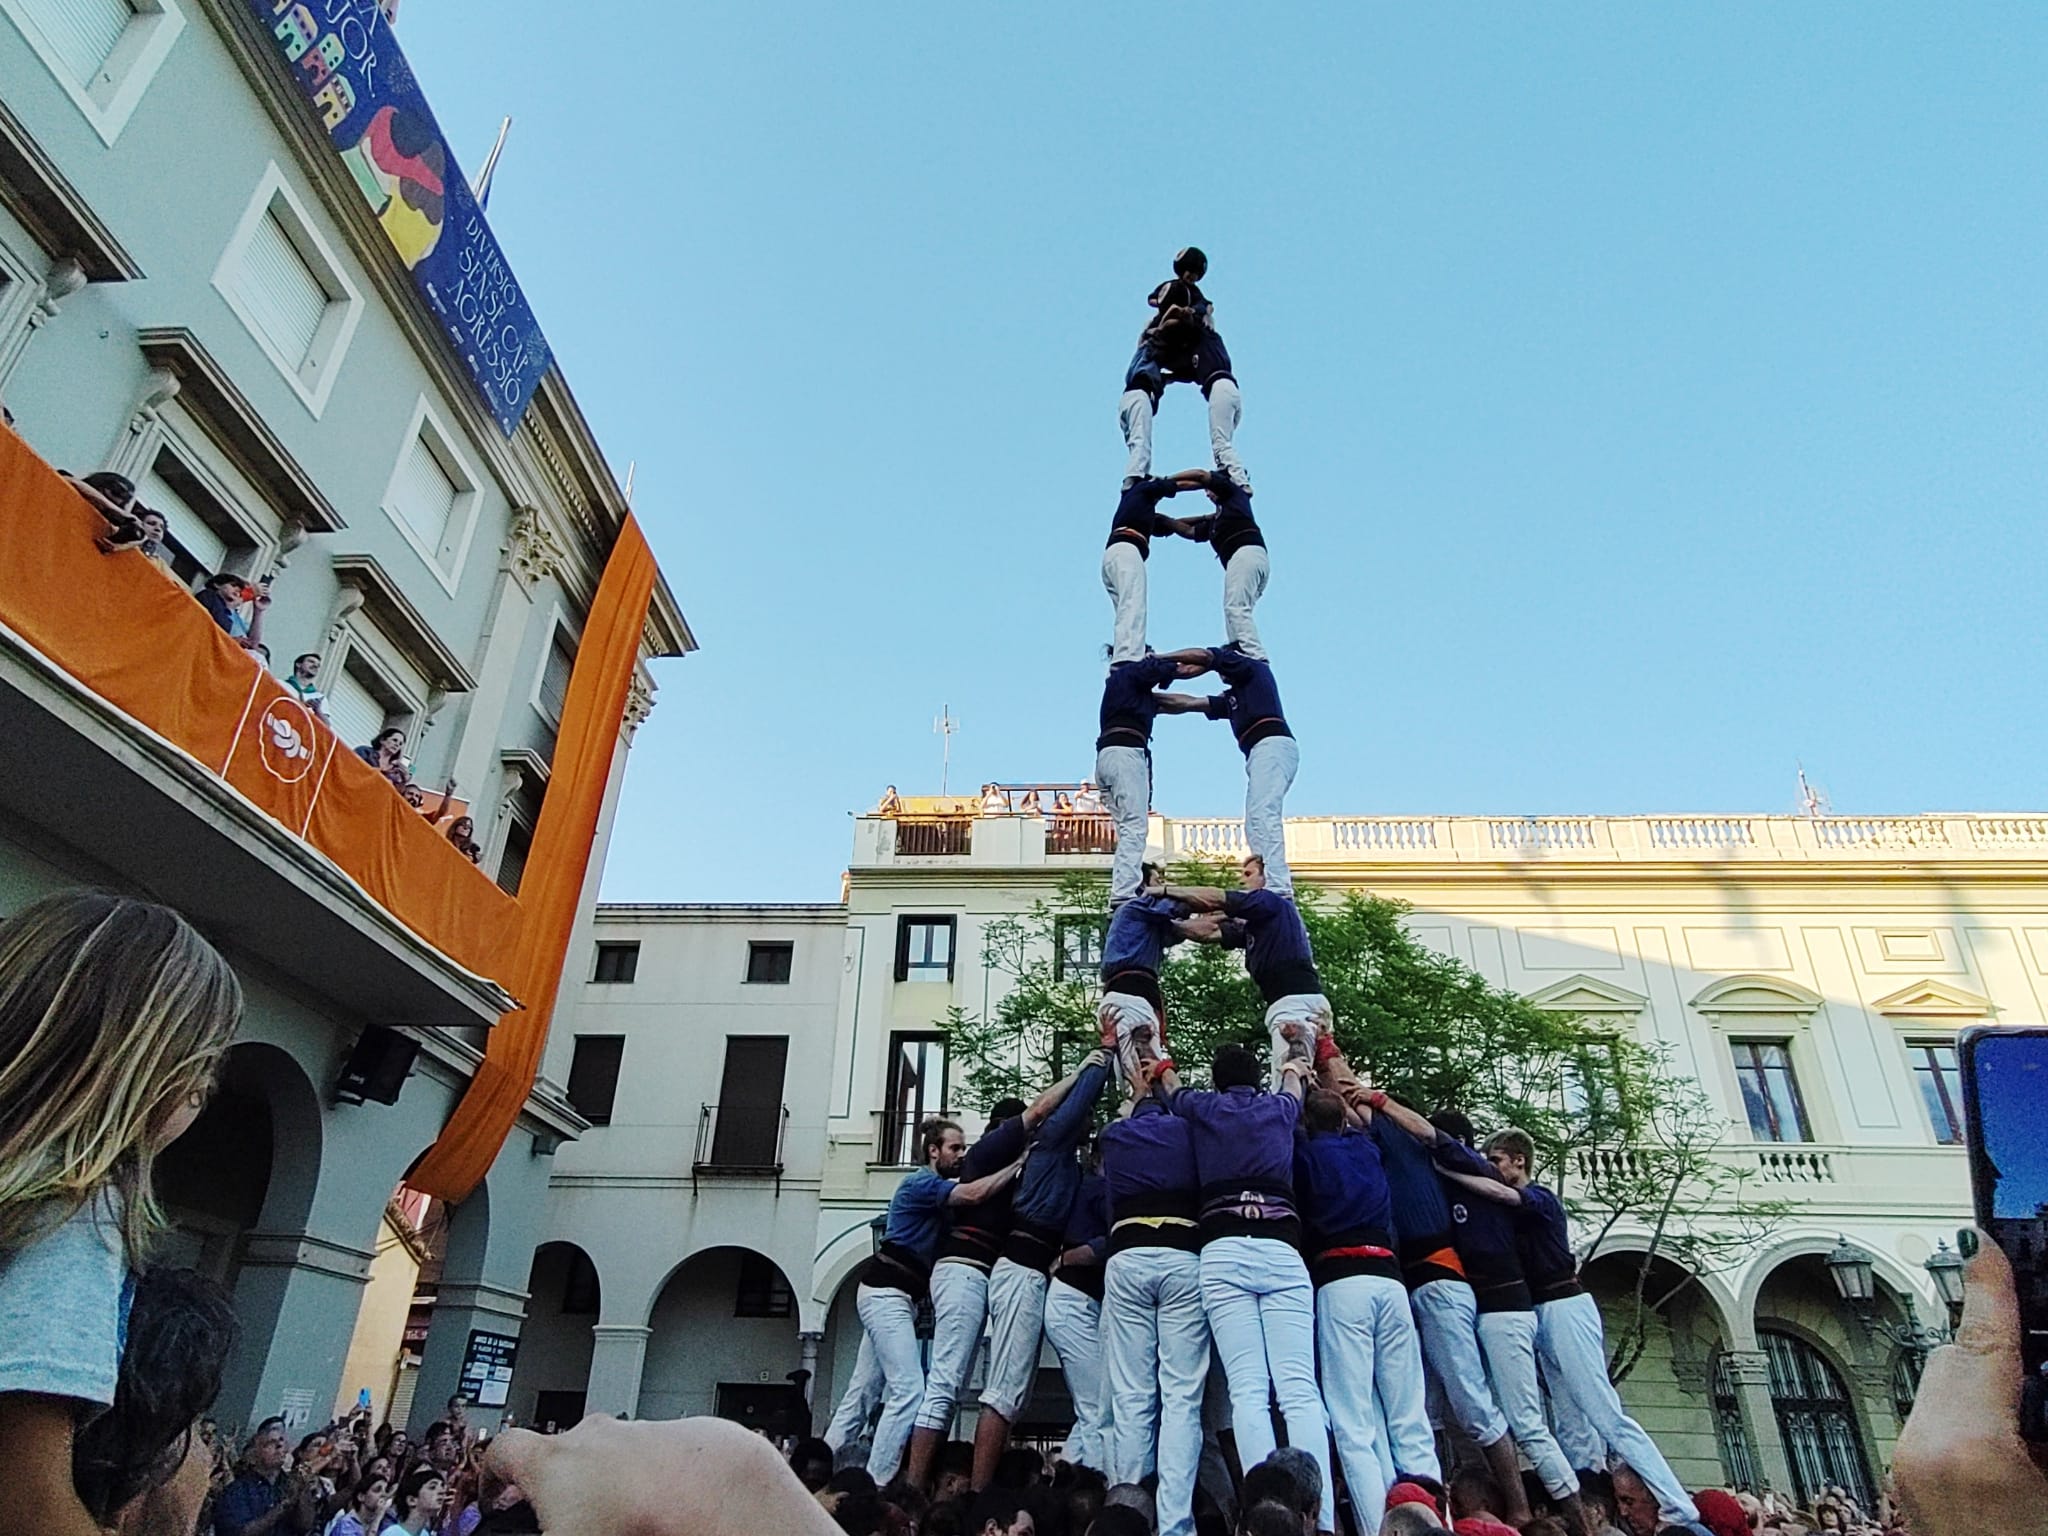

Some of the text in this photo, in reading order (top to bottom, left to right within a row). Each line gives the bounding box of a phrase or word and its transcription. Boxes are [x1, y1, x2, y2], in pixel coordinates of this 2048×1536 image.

[459, 247, 528, 374] SENSE CAP
[466, 216, 516, 305] DIVERSIÓ
[447, 280, 520, 405] AGRESSIÓ
